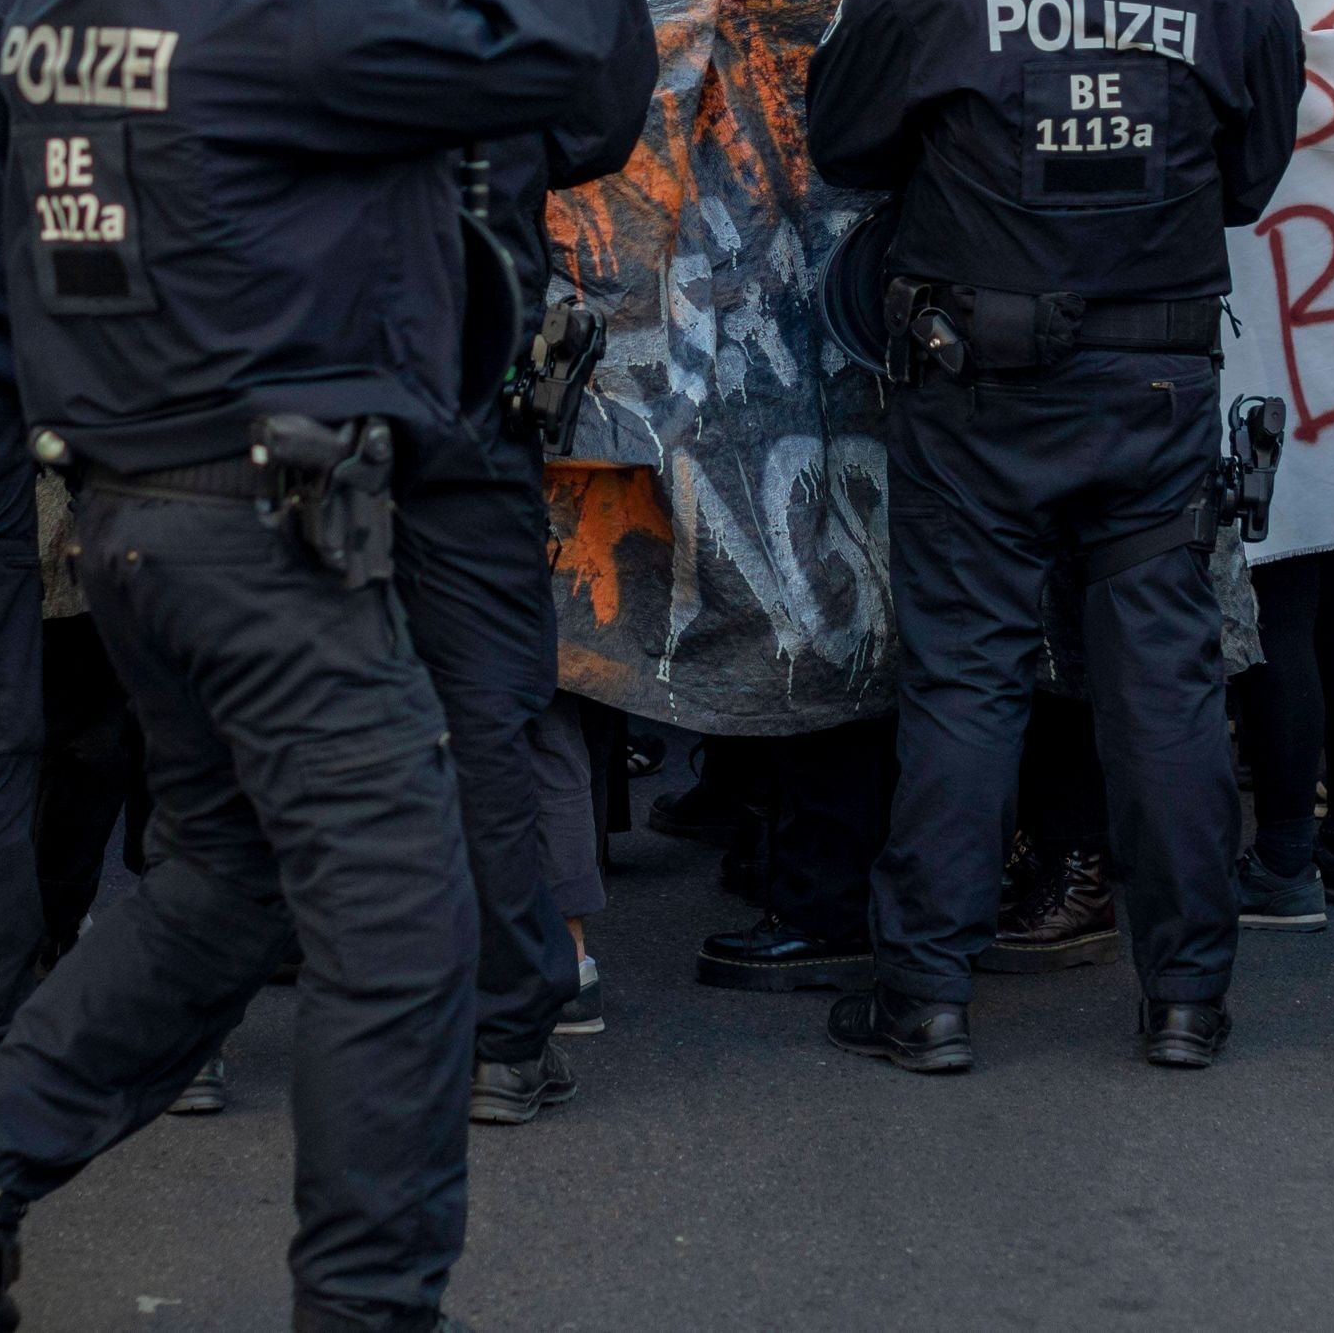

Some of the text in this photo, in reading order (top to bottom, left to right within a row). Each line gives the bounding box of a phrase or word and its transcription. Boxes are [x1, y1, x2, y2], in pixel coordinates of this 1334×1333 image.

[0, 25, 179, 111] POLIZEI
[1070, 73, 1121, 111] BE
[1036, 116, 1153, 152] 1113a
[46, 137, 94, 188] BE
